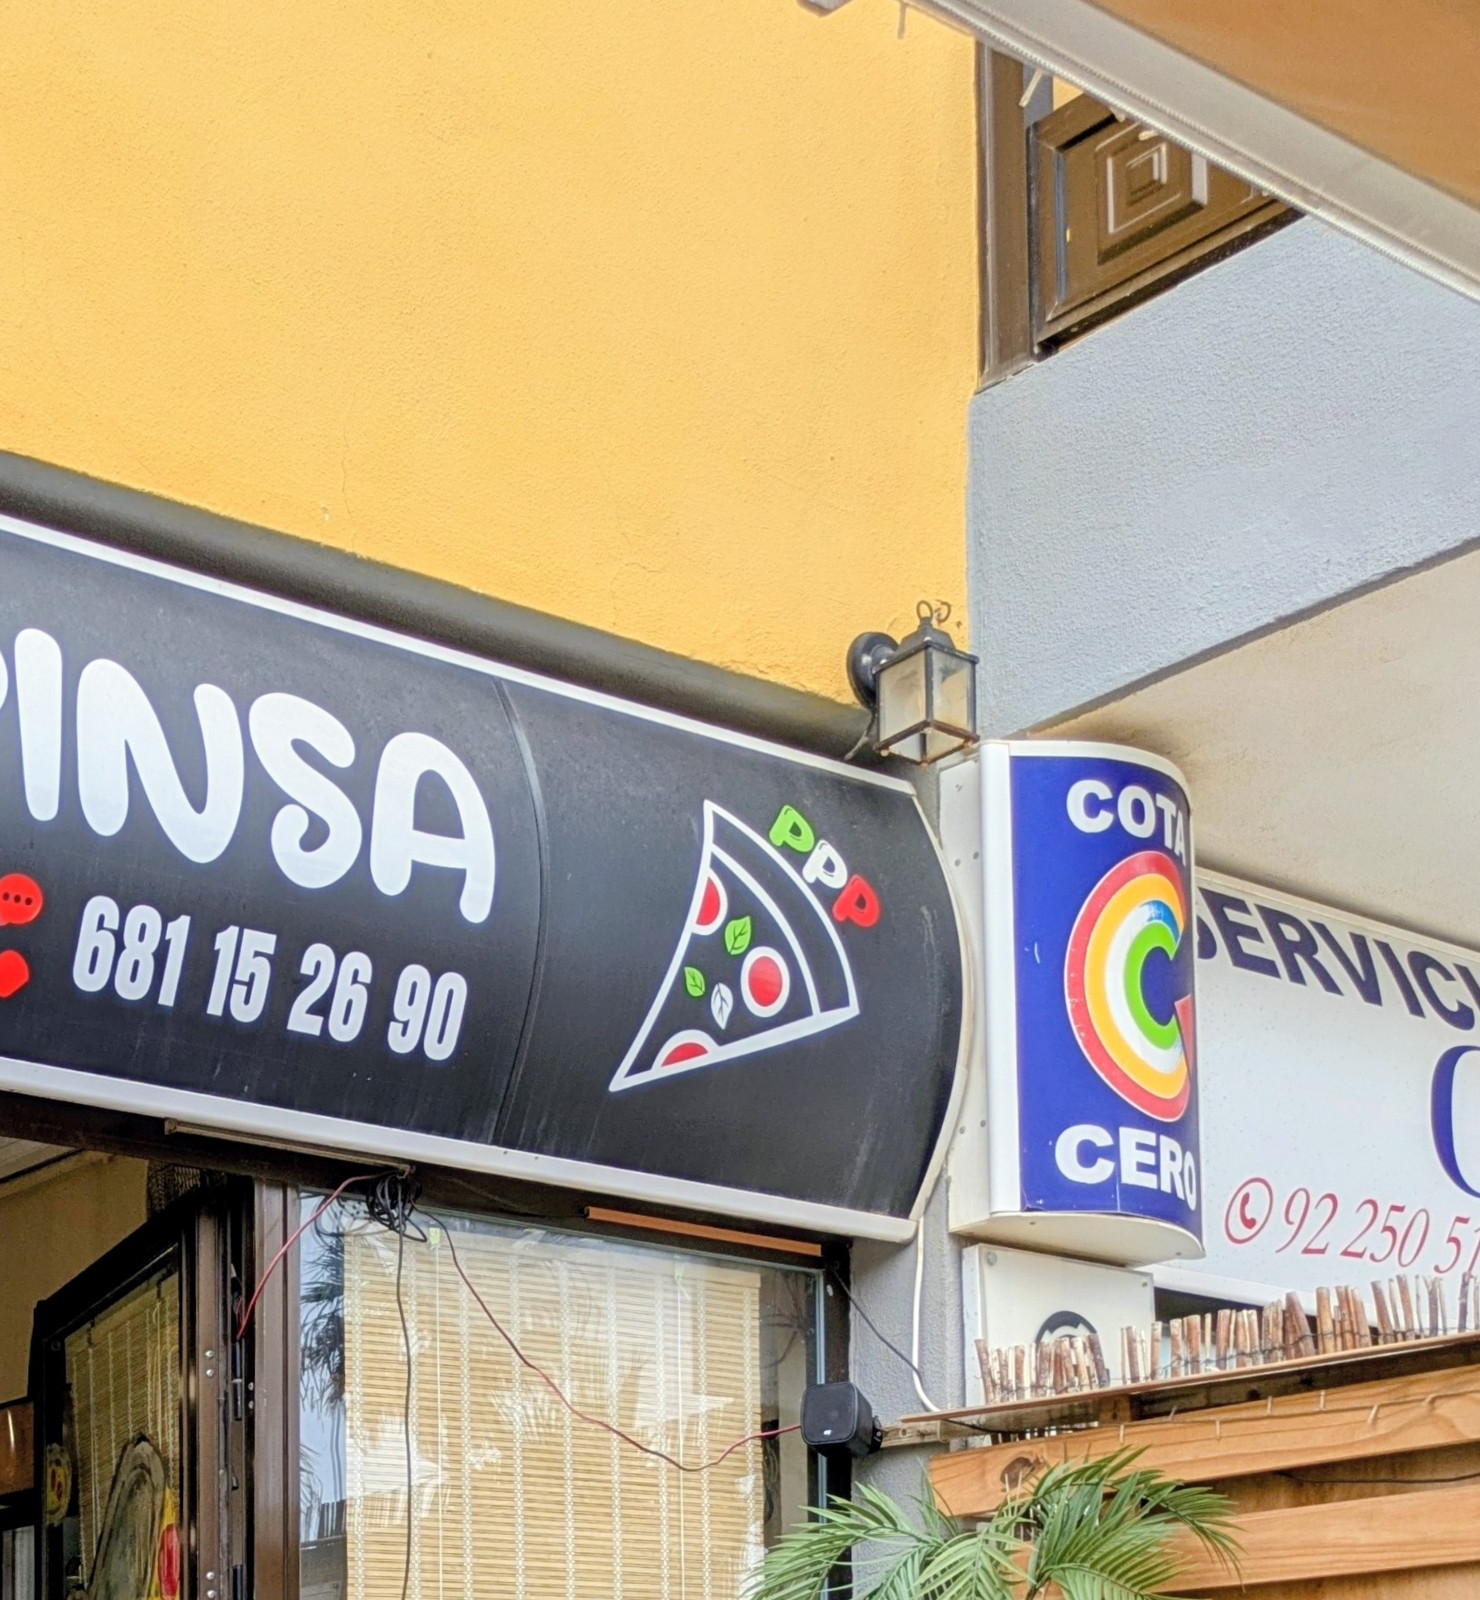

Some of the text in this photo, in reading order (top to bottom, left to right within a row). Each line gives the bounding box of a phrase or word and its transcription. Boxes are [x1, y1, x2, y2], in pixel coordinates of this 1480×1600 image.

[1066, 779, 1187, 868] COTA
[71, 895, 468, 1062] 681 15 26 90
[1055, 1124, 1196, 1211] CERO
[1275, 1188, 1339, 1256] 92
[1340, 1198, 1430, 1268] 250
